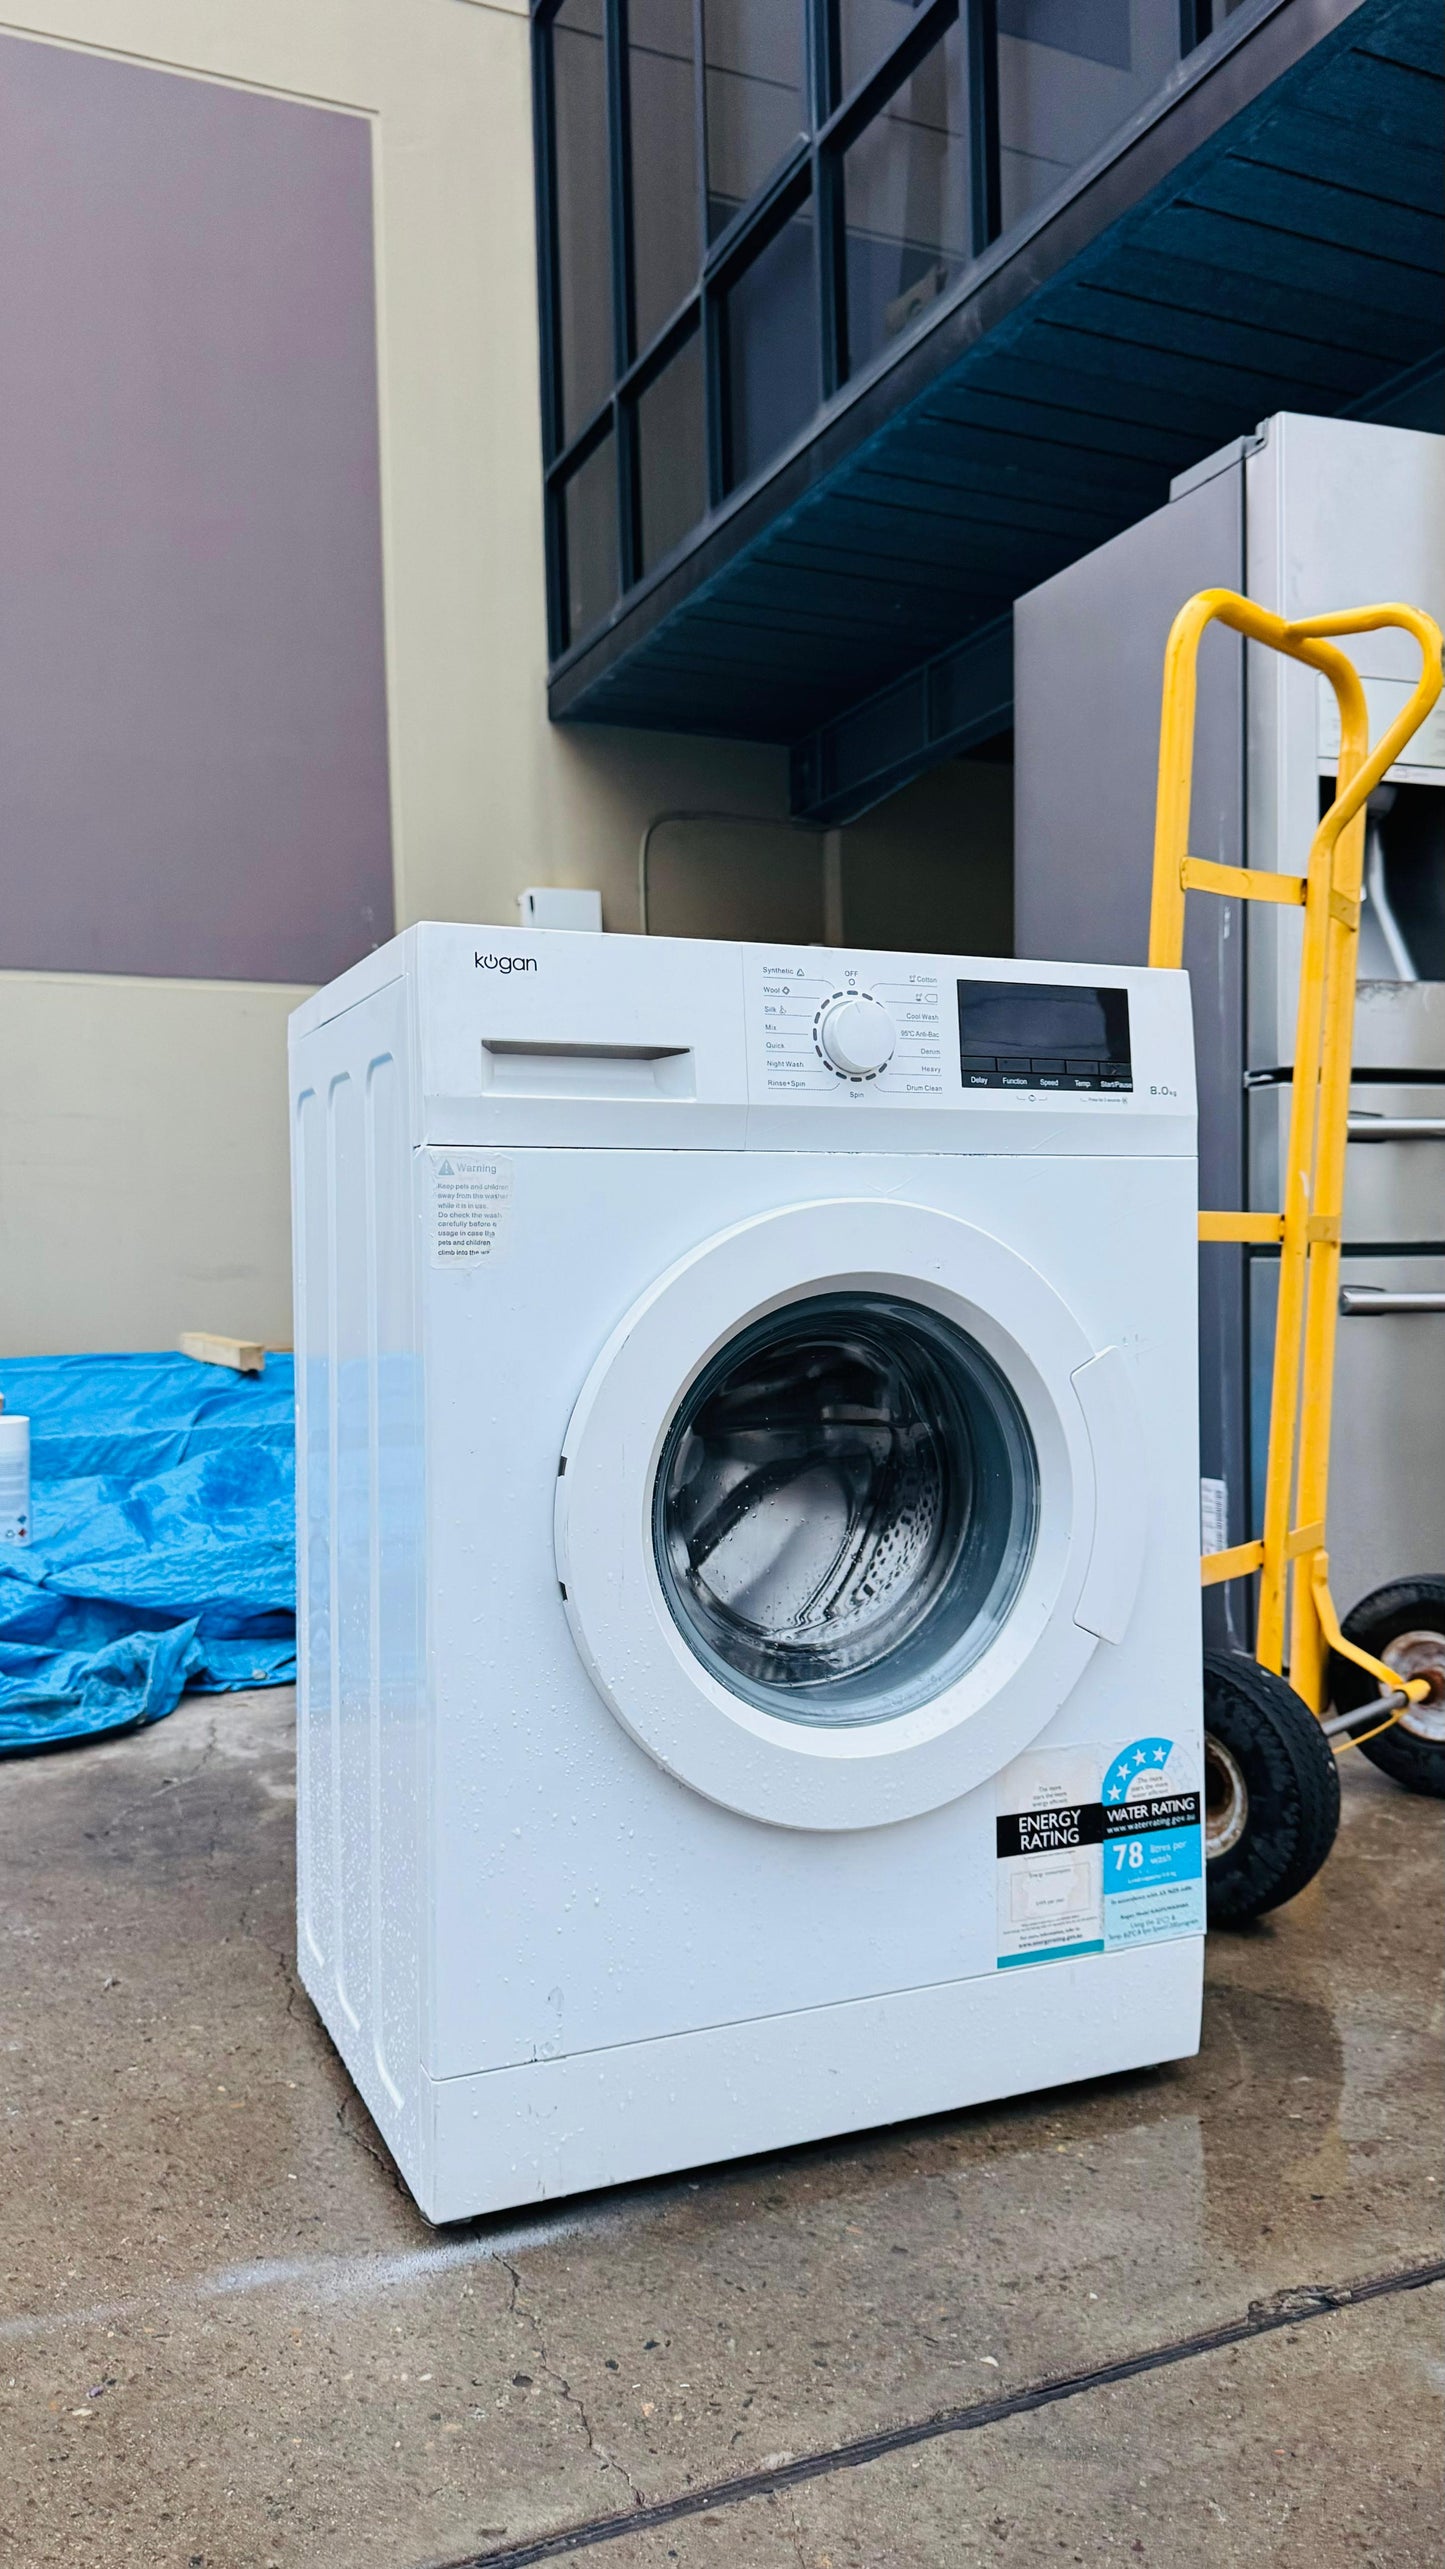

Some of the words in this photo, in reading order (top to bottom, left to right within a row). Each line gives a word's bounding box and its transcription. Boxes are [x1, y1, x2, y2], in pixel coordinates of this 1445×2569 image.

[474, 952, 538, 974] kogan
[762, 966, 794, 974] Synthetic
[763, 986, 780, 994] Wool
[764, 1005, 776, 1013] Silk
[906, 1012, 921, 1020] Cool
[915, 1030, 940, 1038] Anti-Bac
[766, 1060, 785, 1068] Night
[970, 1076, 988, 1085] Delay
[1002, 1076, 1028, 1085] Function
[1040, 1078, 1059, 1087] Speed
[1100, 1081, 1132, 1089] Start/Pause
[849, 1091, 864, 1099] Spin
[456, 1162, 497, 1174] Warning
[1106, 1804, 1149, 1823] WATER
[1151, 1797, 1195, 1816] RATING
[1018, 1809, 1081, 1833] ENERGY
[1020, 1827, 1080, 1851] RATING
[1173, 1841, 1187, 1852] per
[1112, 1841, 1144, 1871] 78
